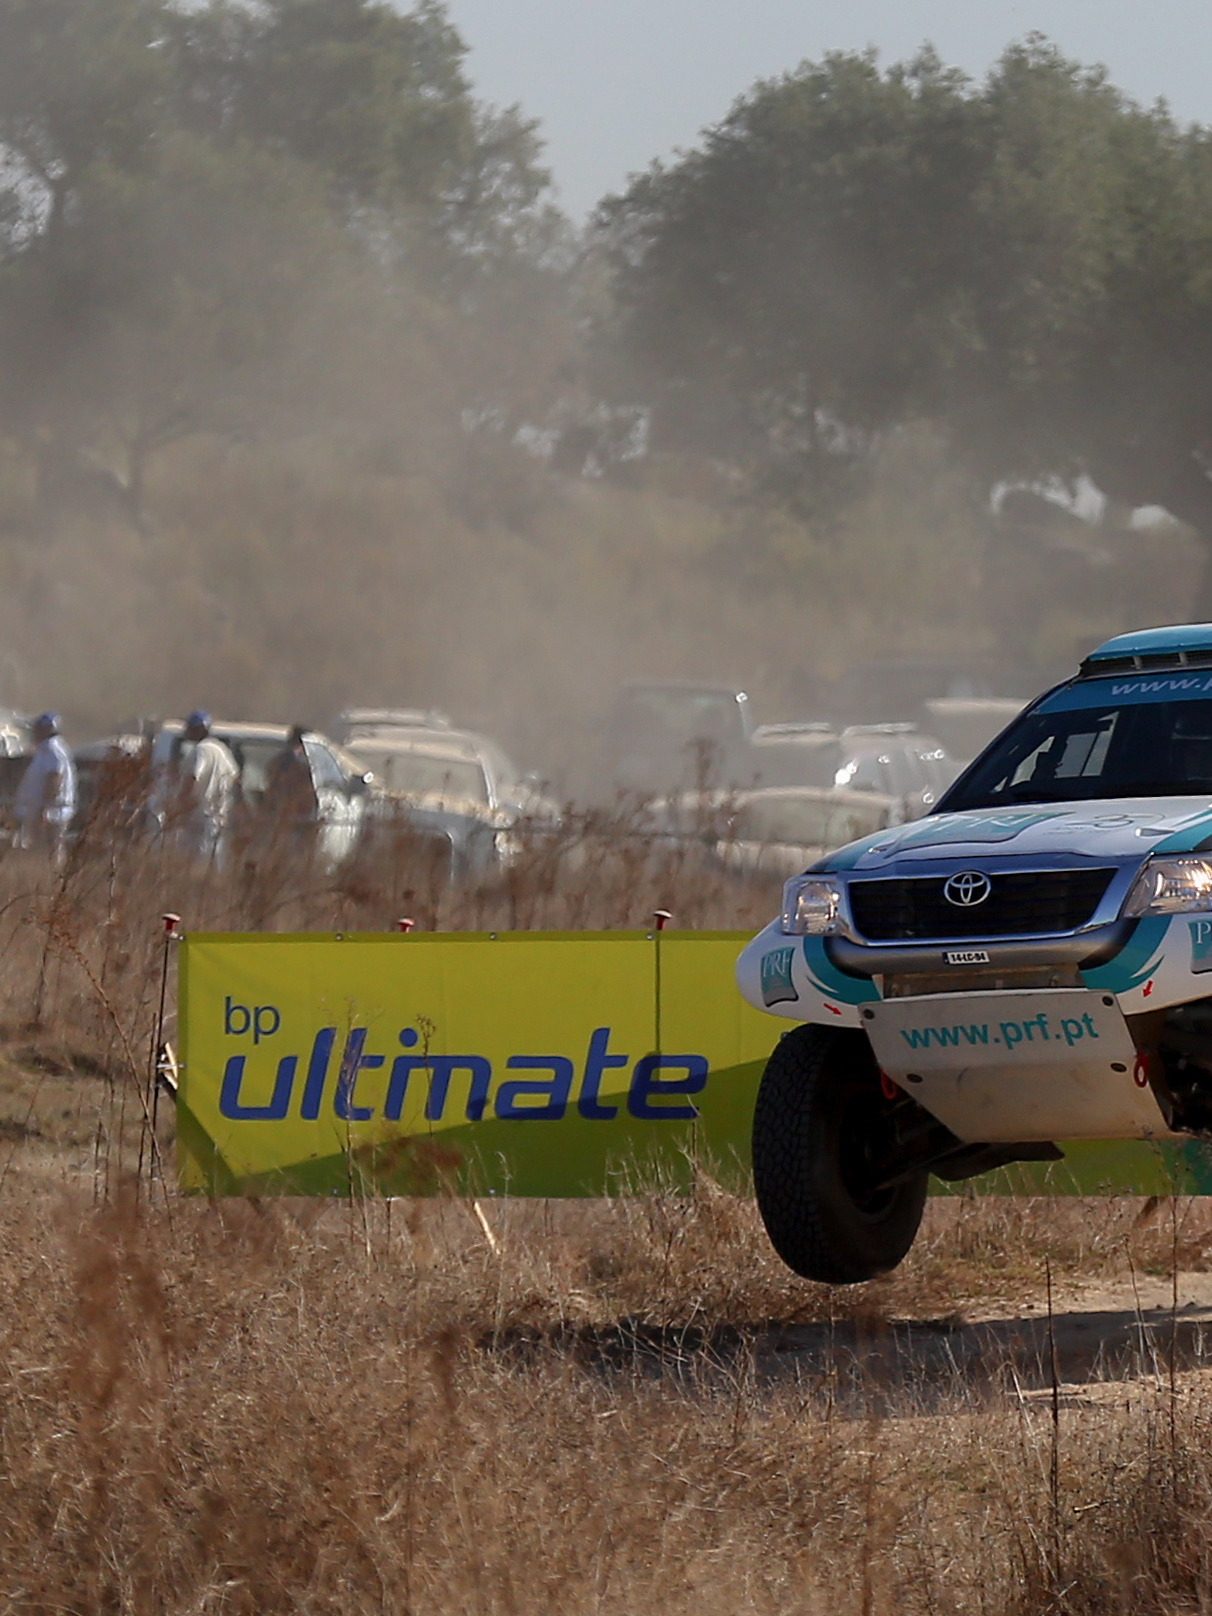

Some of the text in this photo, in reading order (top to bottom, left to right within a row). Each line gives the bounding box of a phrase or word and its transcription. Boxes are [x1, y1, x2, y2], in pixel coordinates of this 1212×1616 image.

[763, 949, 790, 978] PRF
[224, 996, 280, 1044] bp
[901, 1012, 1100, 1050] www.prf.pt
[218, 1027, 709, 1121] ultimate
